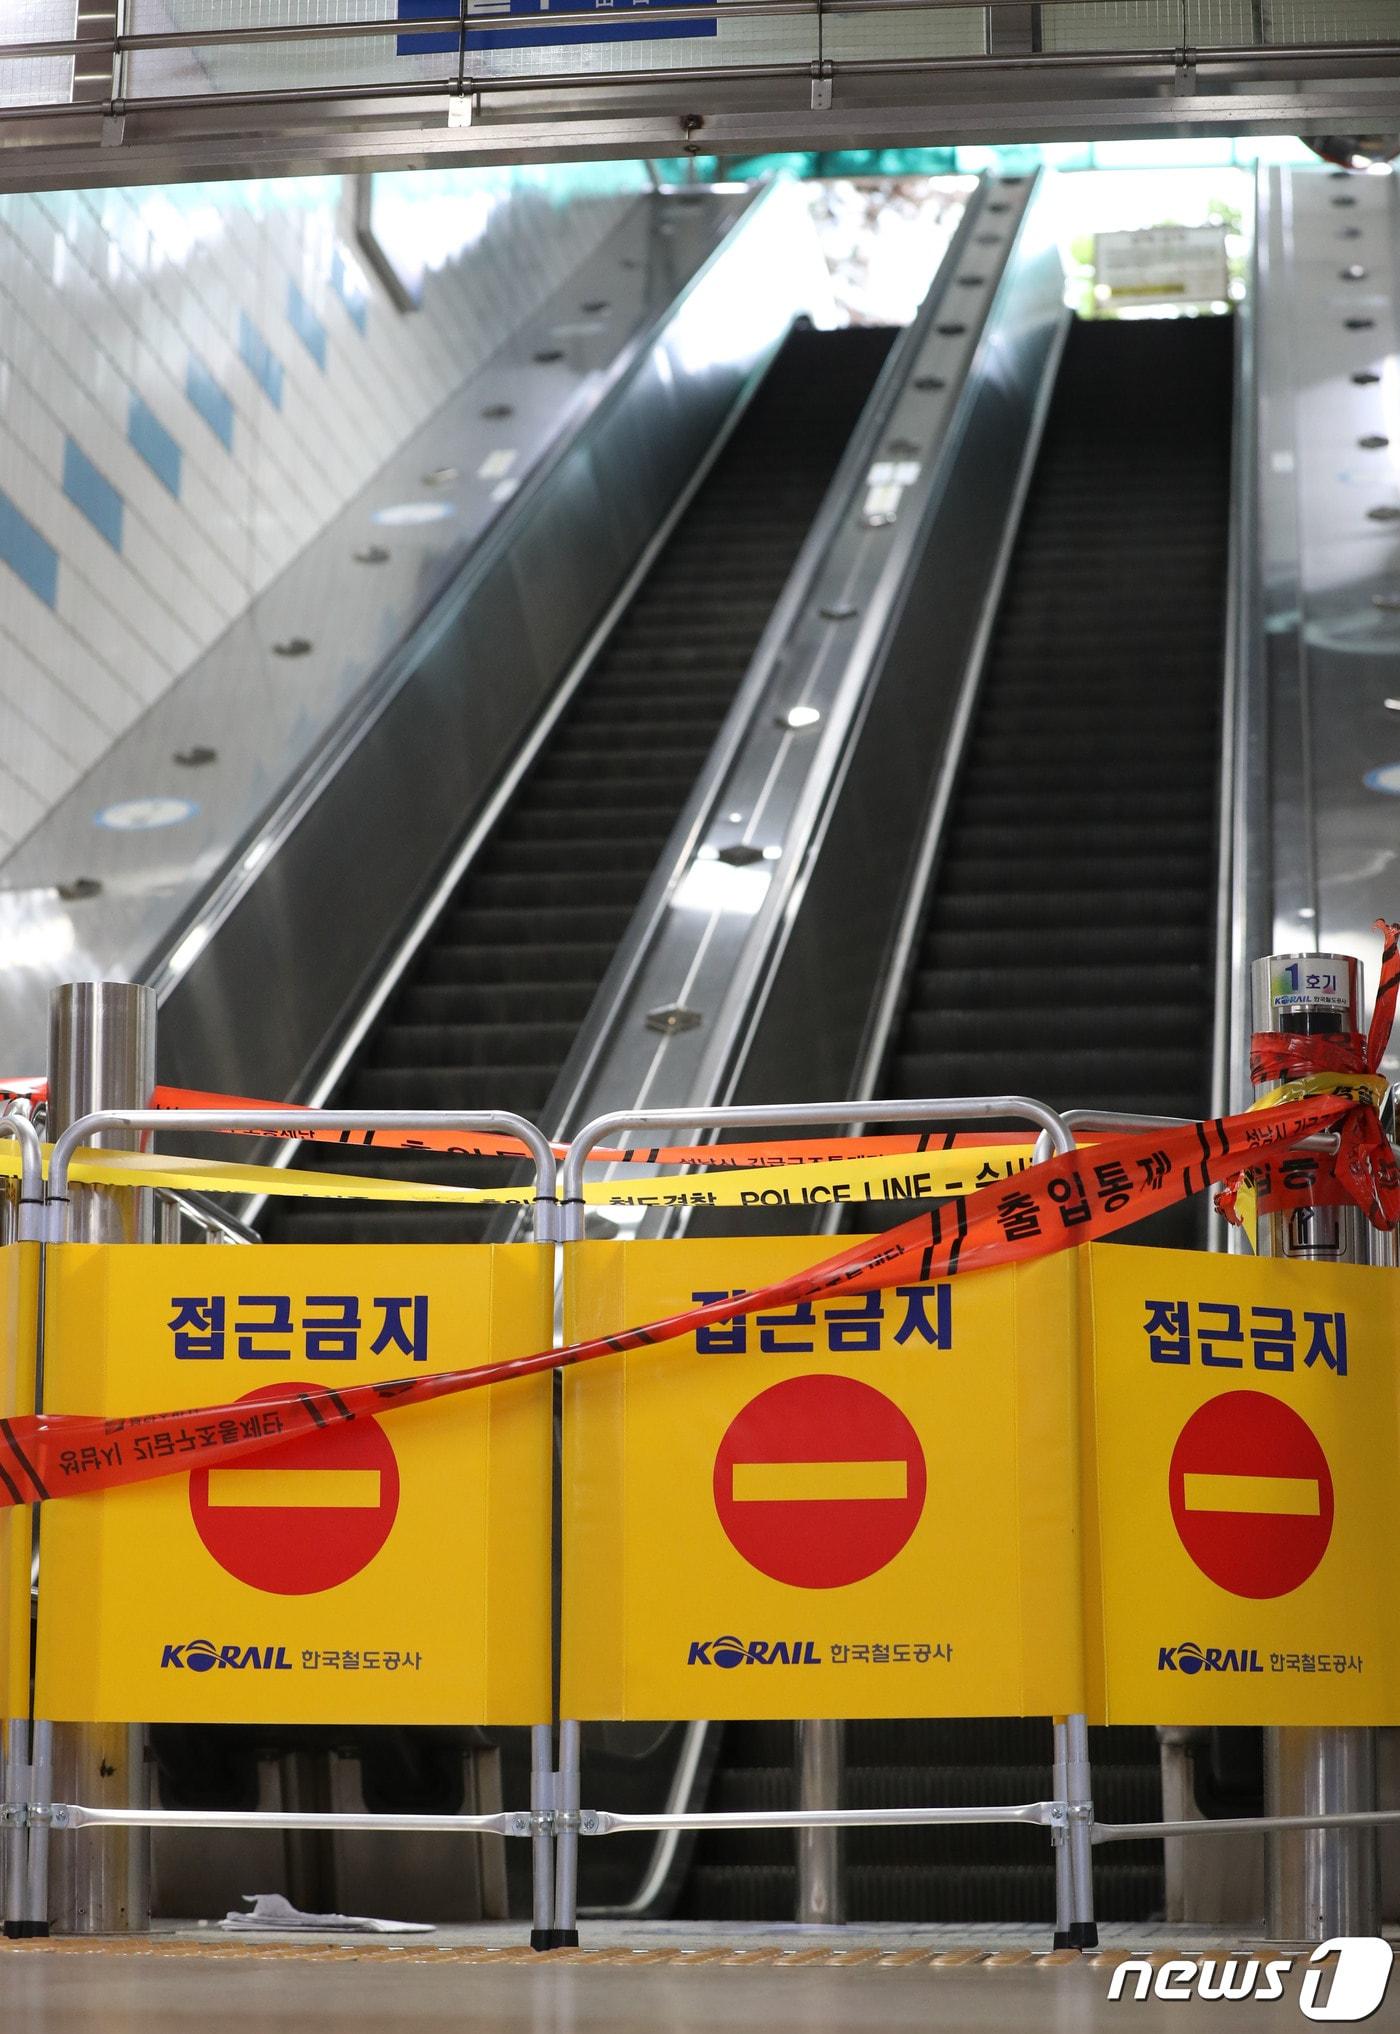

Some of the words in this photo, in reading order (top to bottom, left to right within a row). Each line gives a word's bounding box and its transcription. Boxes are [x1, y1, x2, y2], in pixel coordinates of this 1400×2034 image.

[1285, 963, 1299, 991] 1
[1306, 974, 1337, 991] 호기
[1274, 995, 1313, 1005] KORAIL
[740, 1184, 851, 1206] POLICE
[864, 1172, 932, 1201] LINE
[997, 1150, 1173, 1242] 출입통제
[167, 1295, 429, 1361] 접근금지
[691, 1283, 952, 1354] 접근금지
[1143, 1299, 1348, 1376] 접근금지
[160, 1639, 293, 1673] KORAIL
[302, 1650, 423, 1670] 한국철도공사
[687, 1635, 822, 1669] KORAIL
[830, 1643, 954, 1663] 한국철도공사
[1158, 1641, 1264, 1675] KORAIL
[1269, 1652, 1364, 1674] 한국철도공사
